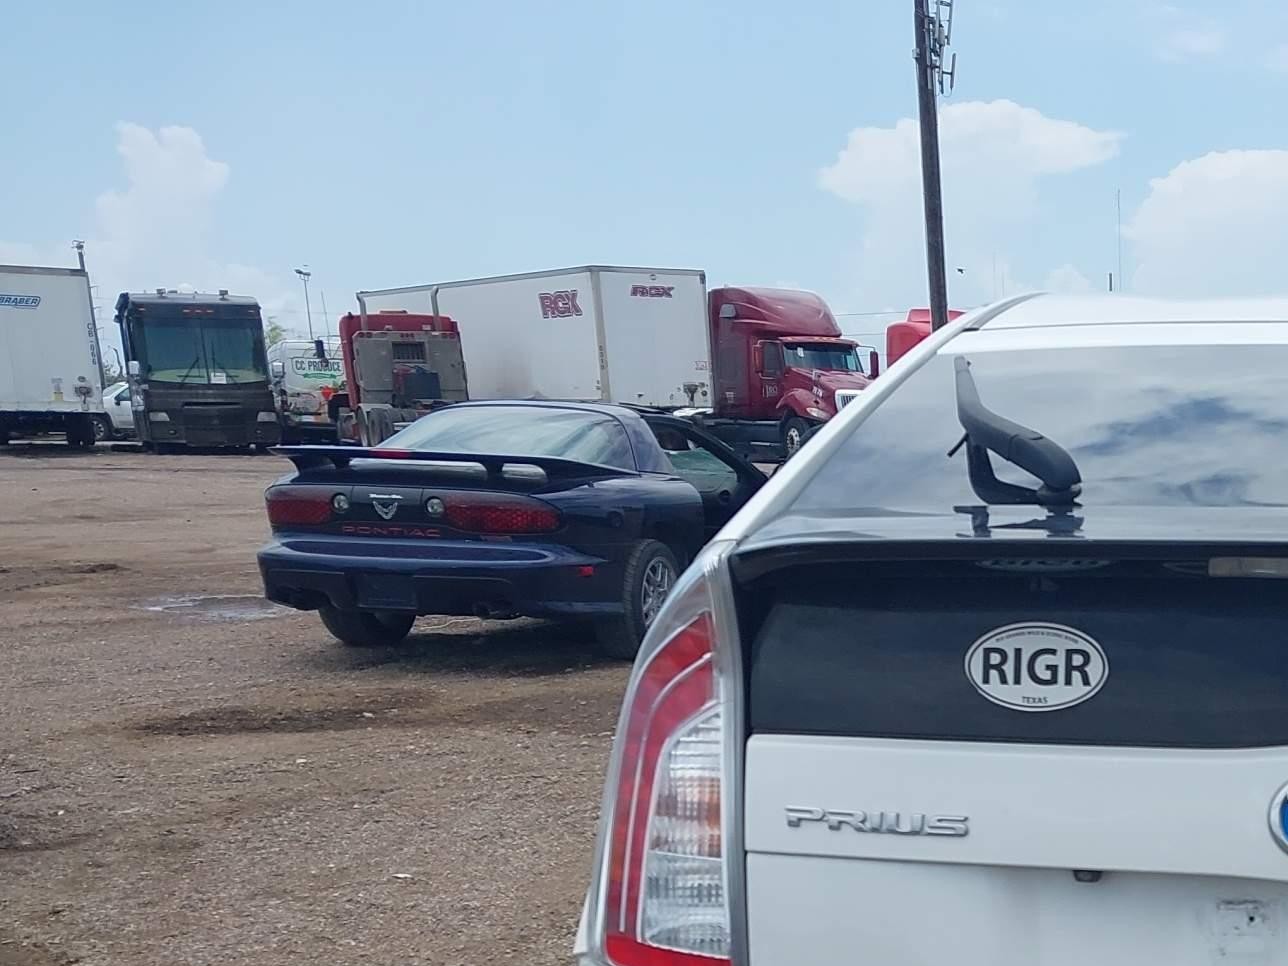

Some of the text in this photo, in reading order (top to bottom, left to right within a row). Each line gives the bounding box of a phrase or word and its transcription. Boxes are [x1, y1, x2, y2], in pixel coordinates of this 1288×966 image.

[538, 290, 583, 318] RCX
[307, 360, 342, 371] PROUCE
[343, 526, 441, 537] PONTIAC
[982, 647, 1092, 687] RIGR
[1022, 696, 1048, 704] TEXAS
[784, 804, 969, 837] PRIUS
